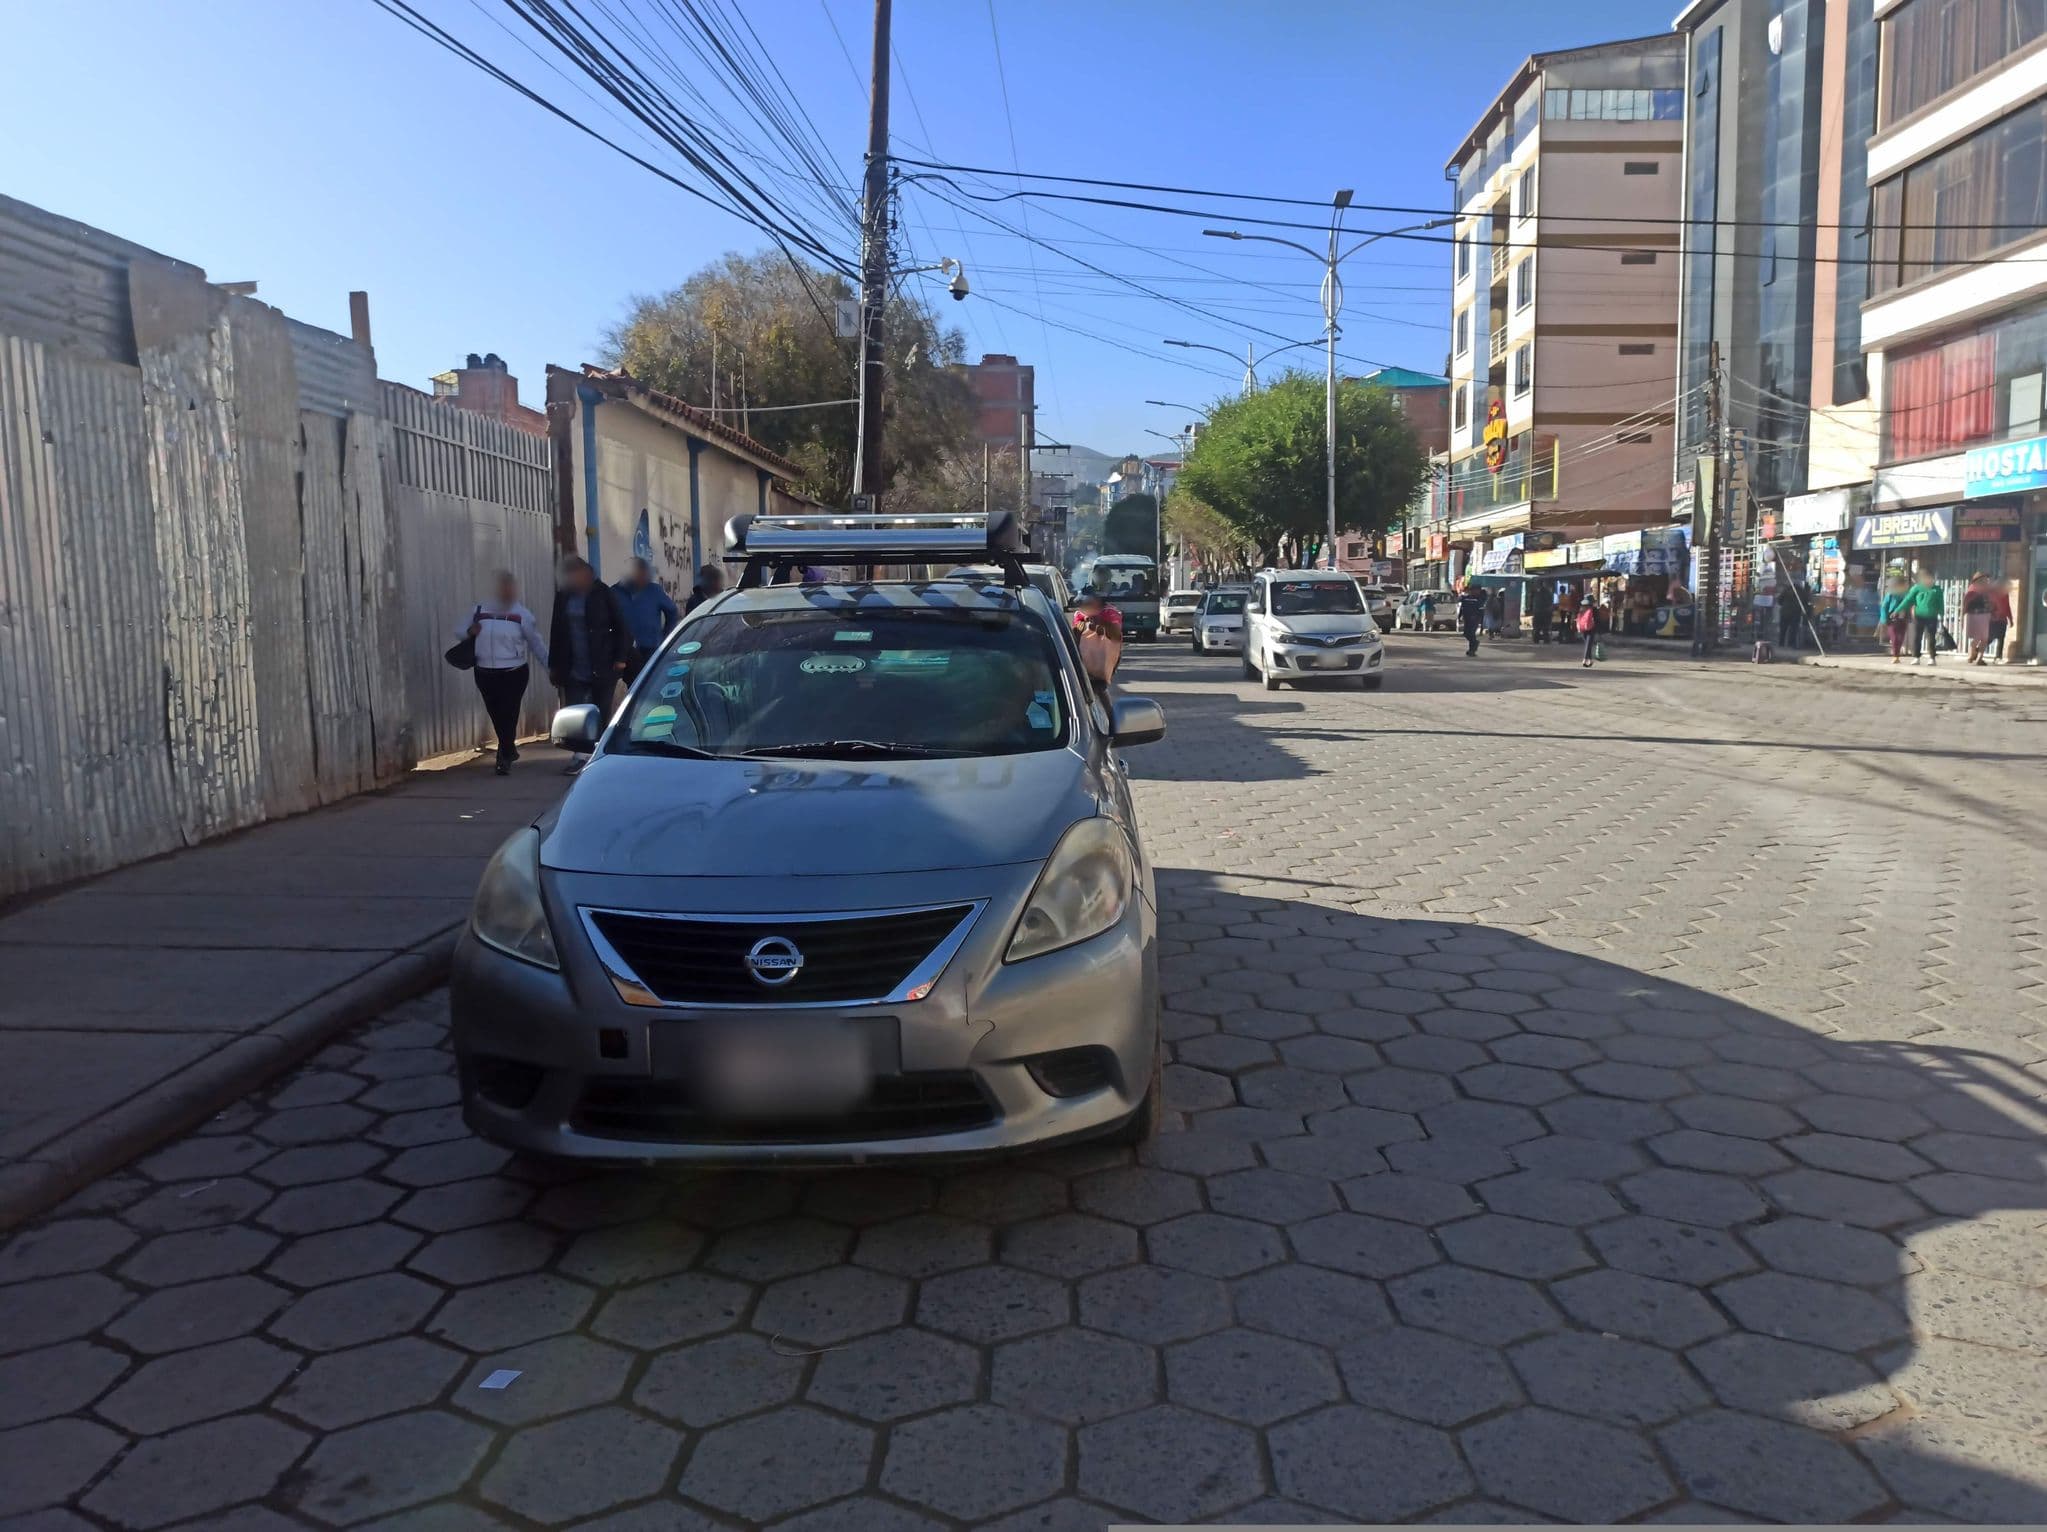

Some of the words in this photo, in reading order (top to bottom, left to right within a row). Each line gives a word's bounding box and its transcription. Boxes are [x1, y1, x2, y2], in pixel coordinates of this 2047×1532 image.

[1966, 442, 2047, 482] HOSTA
[1871, 512, 1932, 536] LIBRERIA
[751, 958, 797, 966] NISSAN
